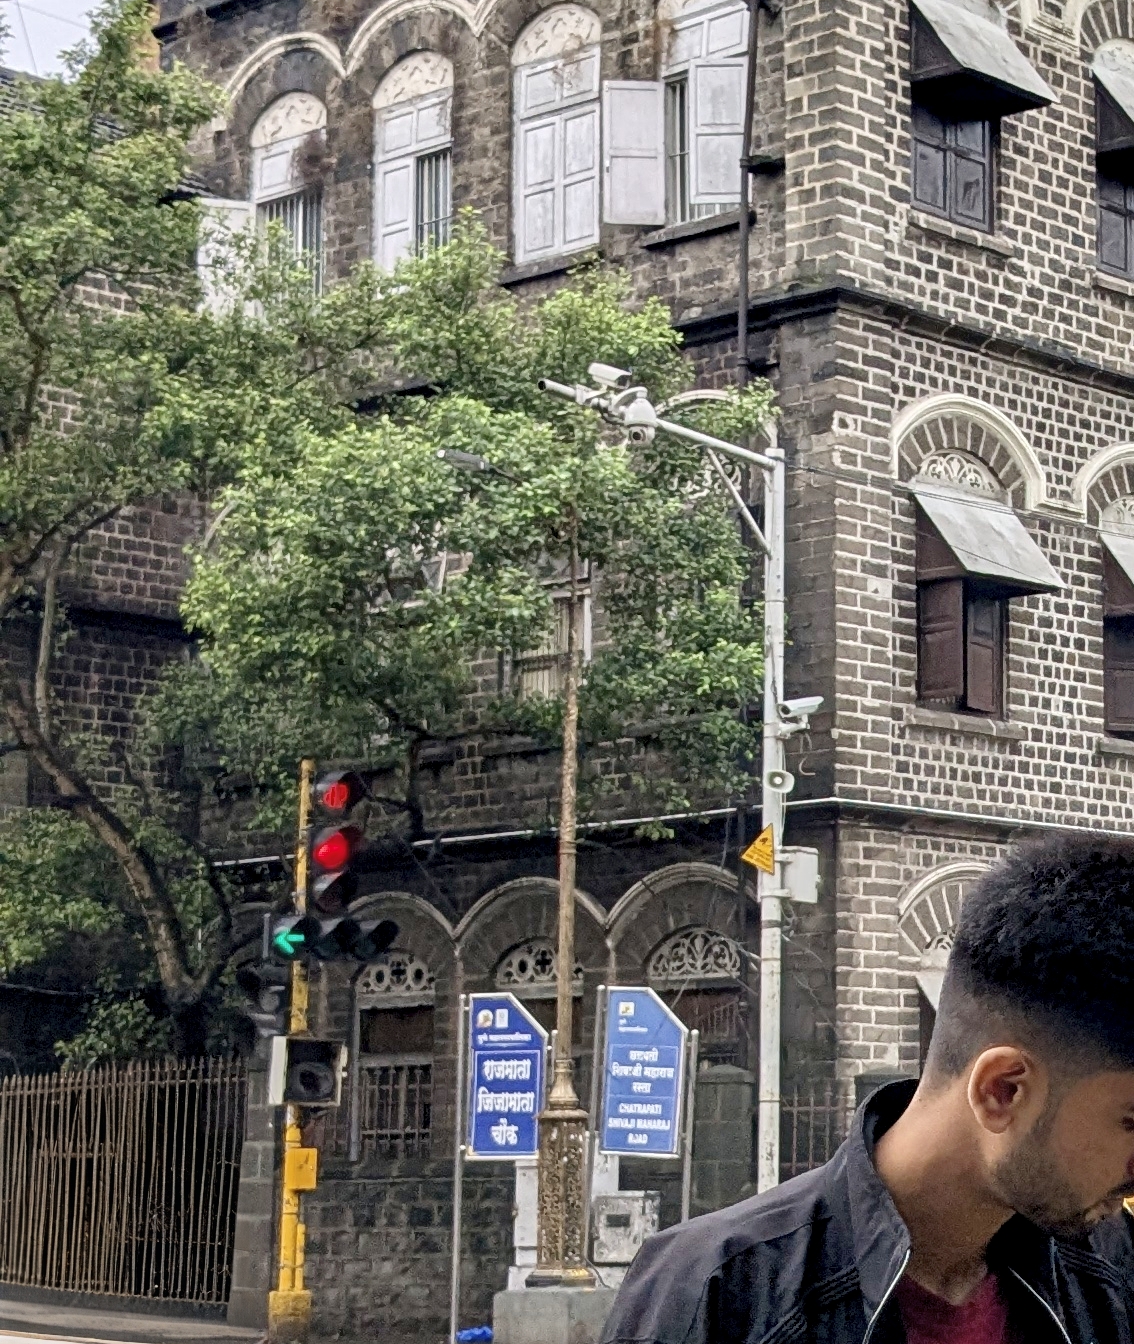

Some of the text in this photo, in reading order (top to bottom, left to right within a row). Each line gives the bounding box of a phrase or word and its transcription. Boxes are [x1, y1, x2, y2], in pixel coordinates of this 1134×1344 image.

[483, 1059, 531, 1080] राजमाता
[477, 1086, 534, 1112] जिजामाता
[491, 1118, 519, 1145] चौक
[608, 1117, 671, 1130] SHIVAJI MAHARAJ
